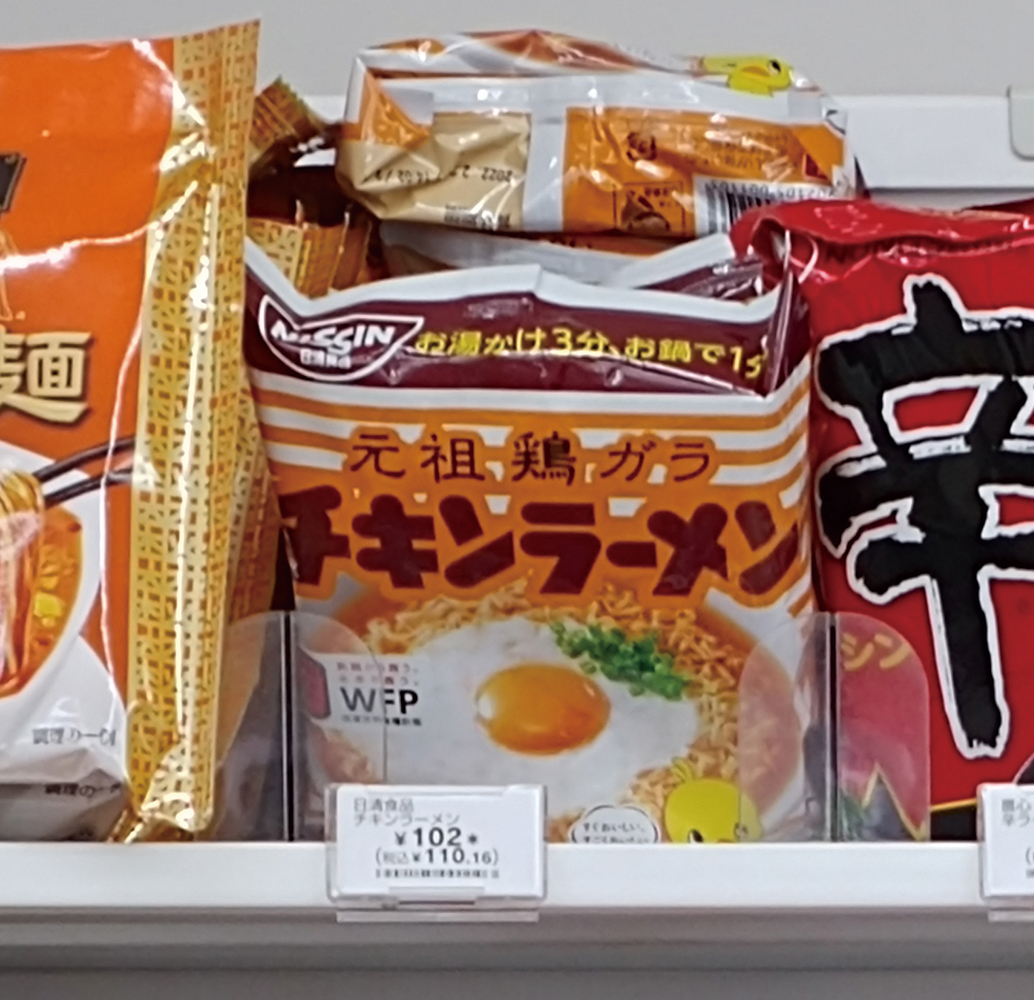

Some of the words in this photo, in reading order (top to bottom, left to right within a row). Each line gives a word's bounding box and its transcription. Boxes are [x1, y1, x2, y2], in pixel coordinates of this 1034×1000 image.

[350, 431, 710, 486] 元祖鶏ガラ
[278, 484, 799, 597] チキンラーメン
